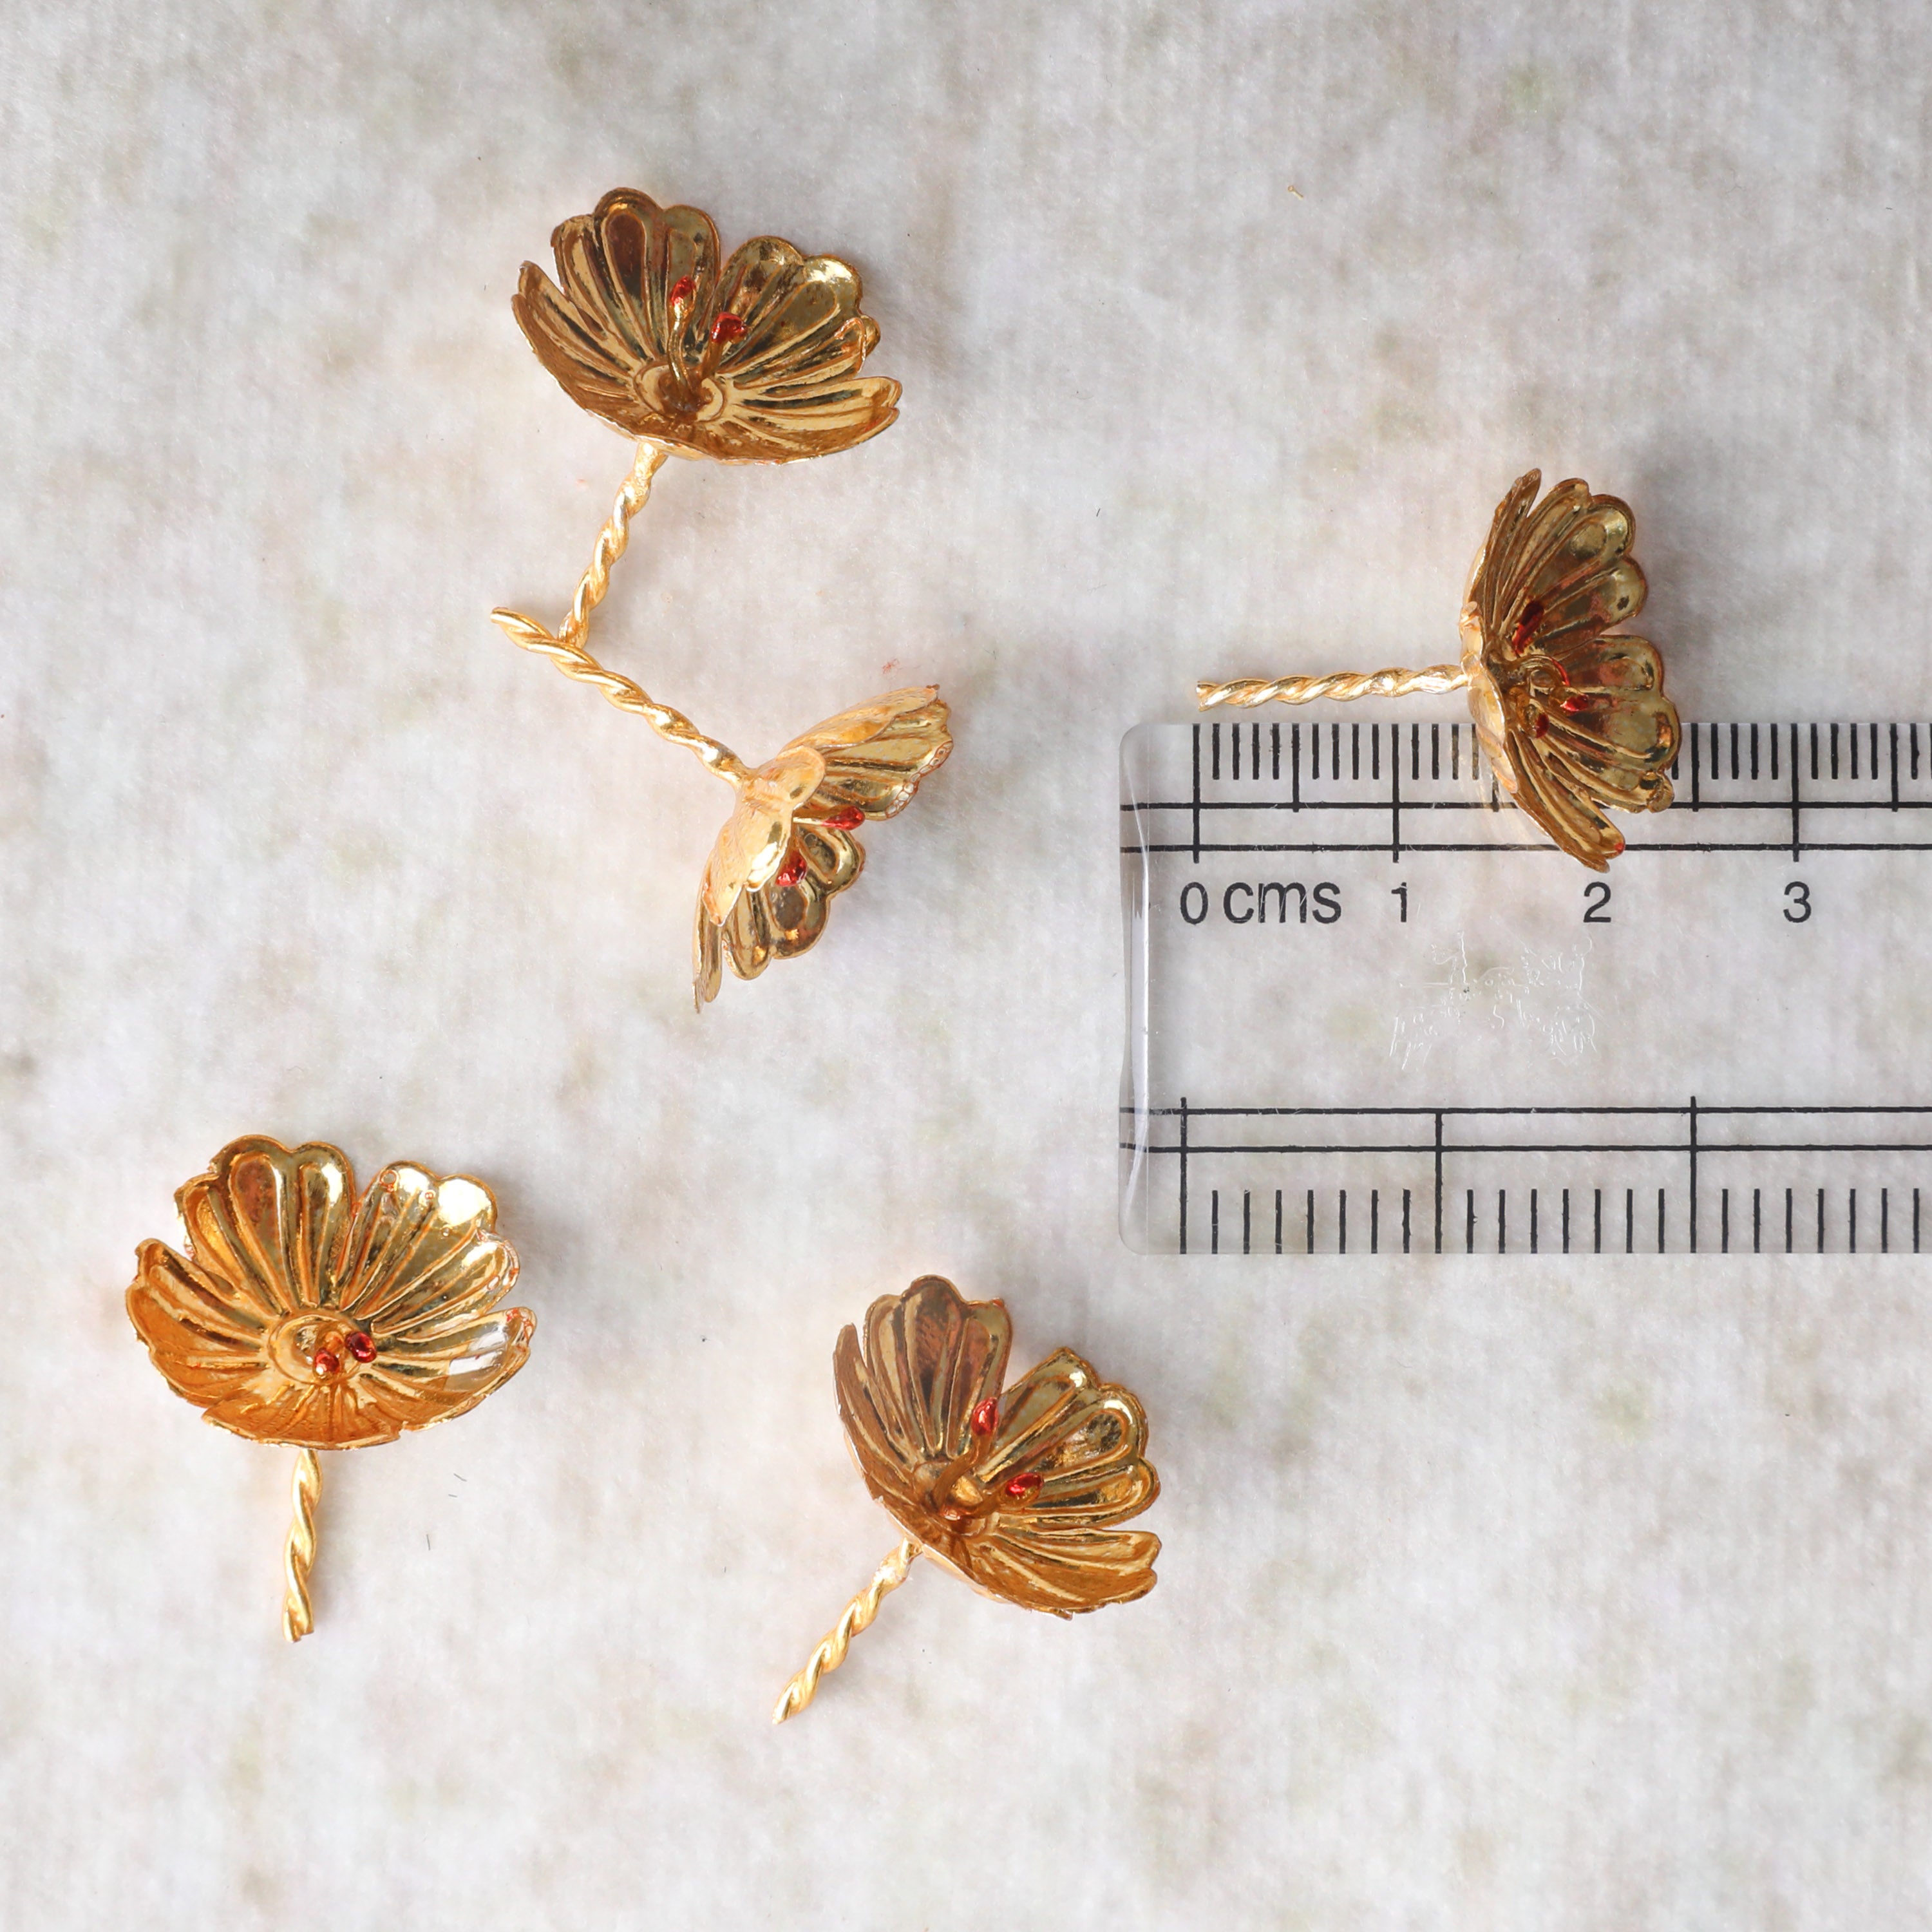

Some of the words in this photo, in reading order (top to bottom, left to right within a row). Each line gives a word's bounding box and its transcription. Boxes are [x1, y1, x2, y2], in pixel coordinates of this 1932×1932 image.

[1180, 882, 1209, 925] 0
[1223, 882, 1341, 924] cms
[1391, 882, 1407, 923] 1
[1583, 881, 1611, 923] 2
[1783, 881, 1812, 923] 3
